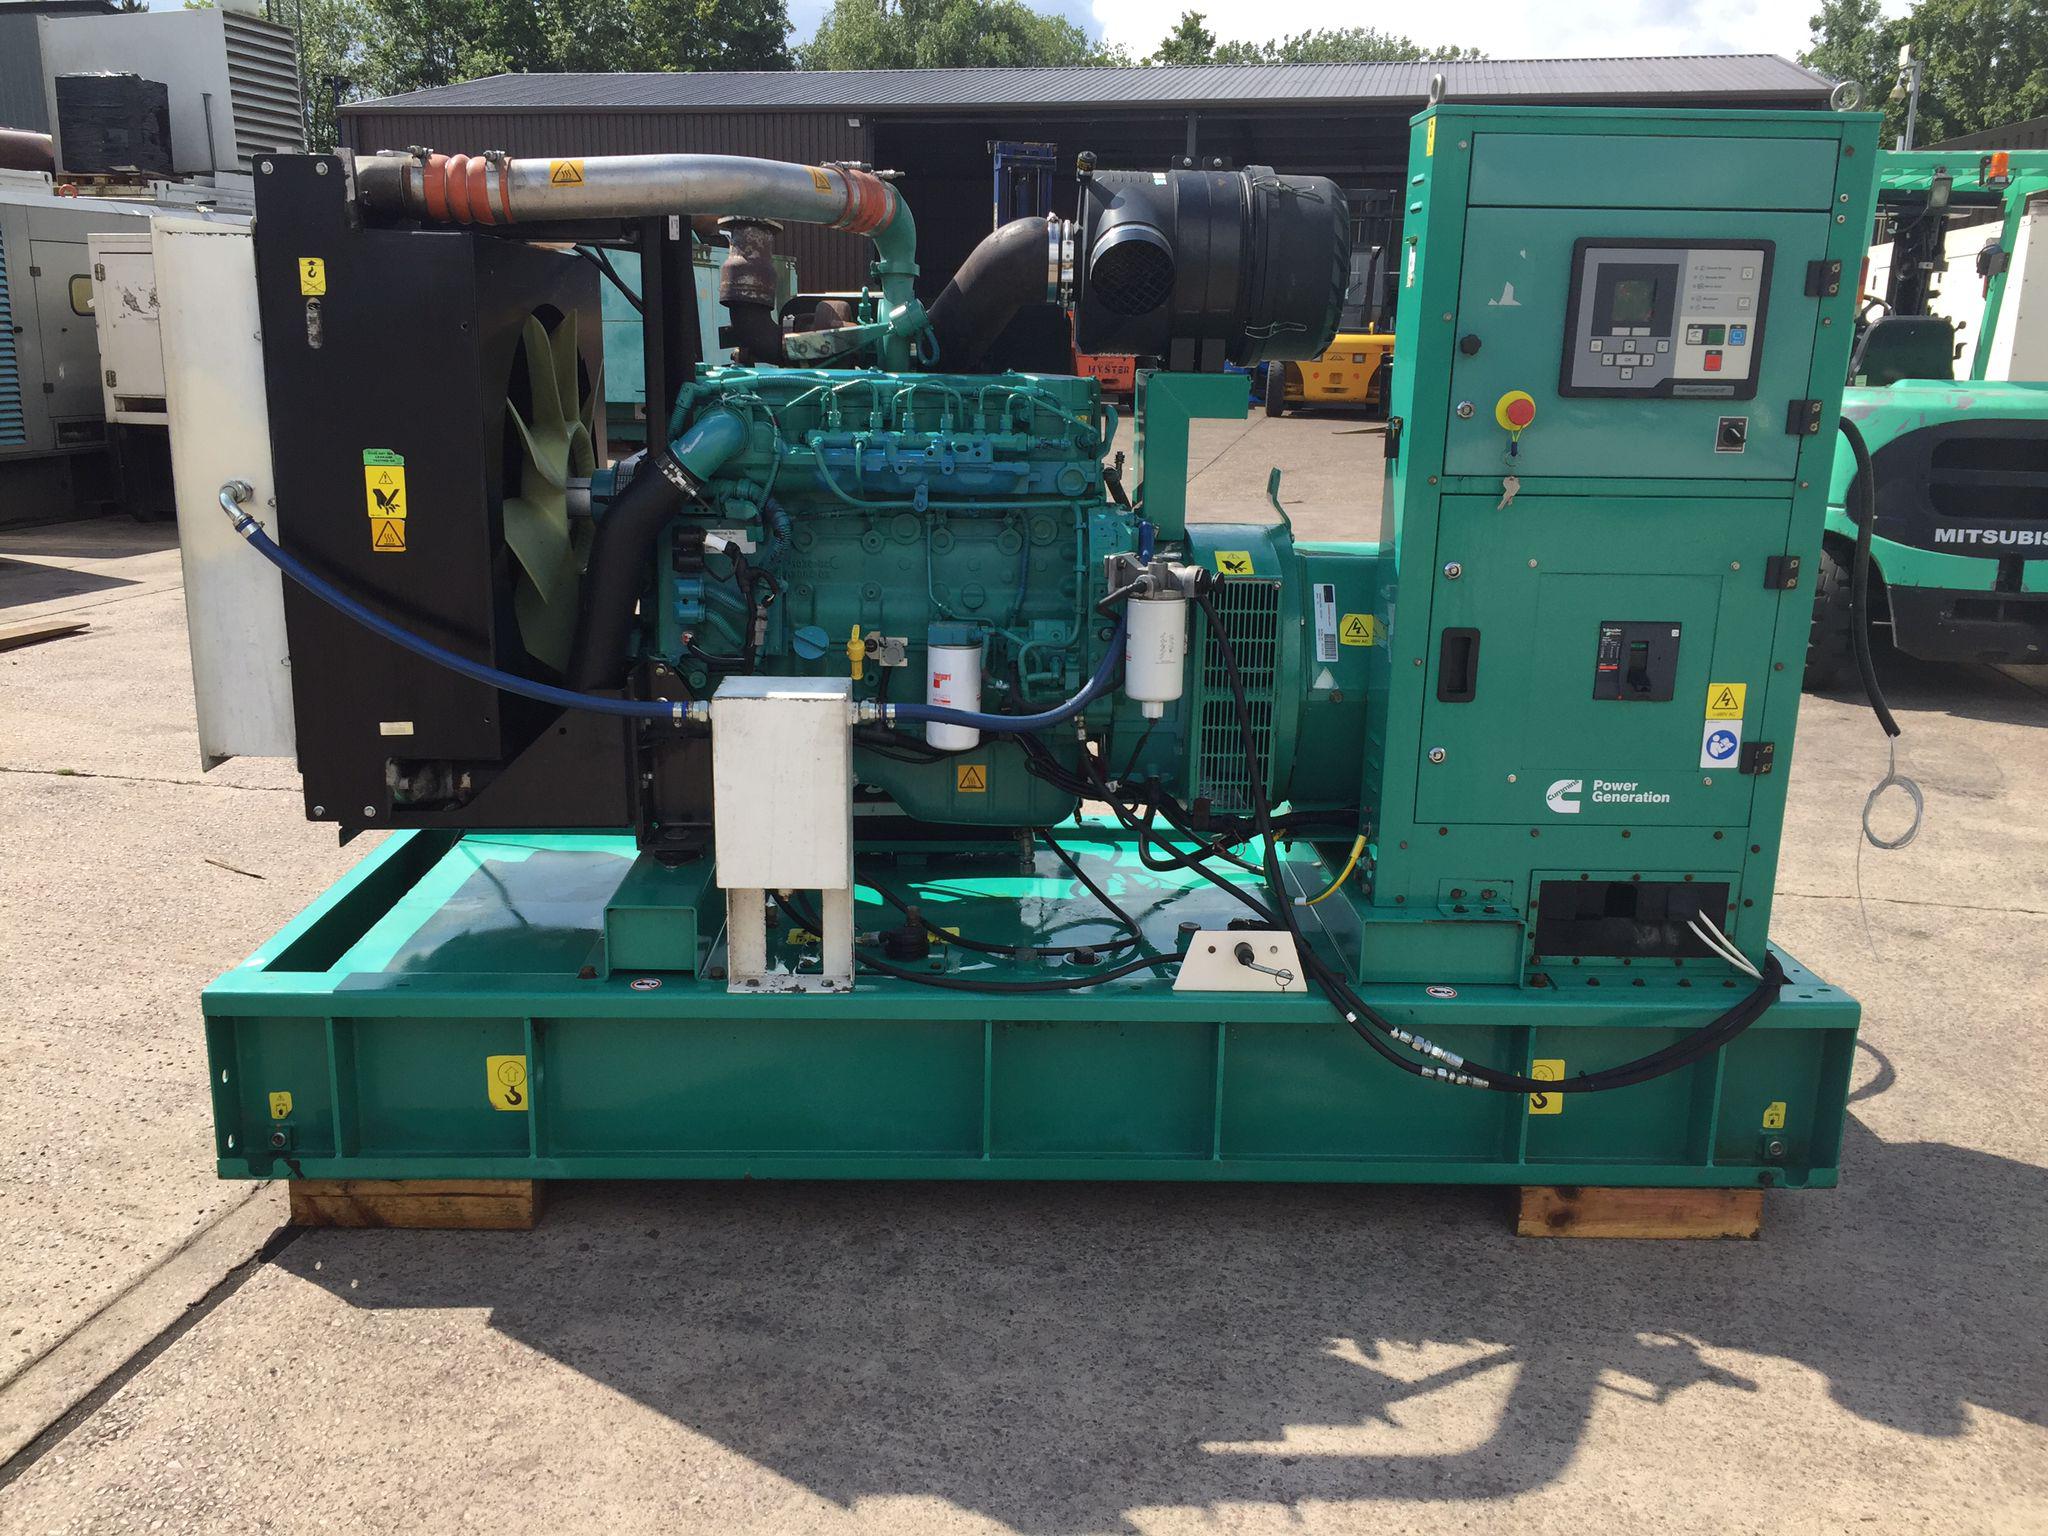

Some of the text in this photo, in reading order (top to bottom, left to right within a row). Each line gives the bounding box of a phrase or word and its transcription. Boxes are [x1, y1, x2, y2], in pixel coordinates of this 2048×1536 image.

[1088, 365, 1129, 374] HYSTER
[1593, 780, 1638, 791] Power
[1592, 791, 1670, 803] Generation
